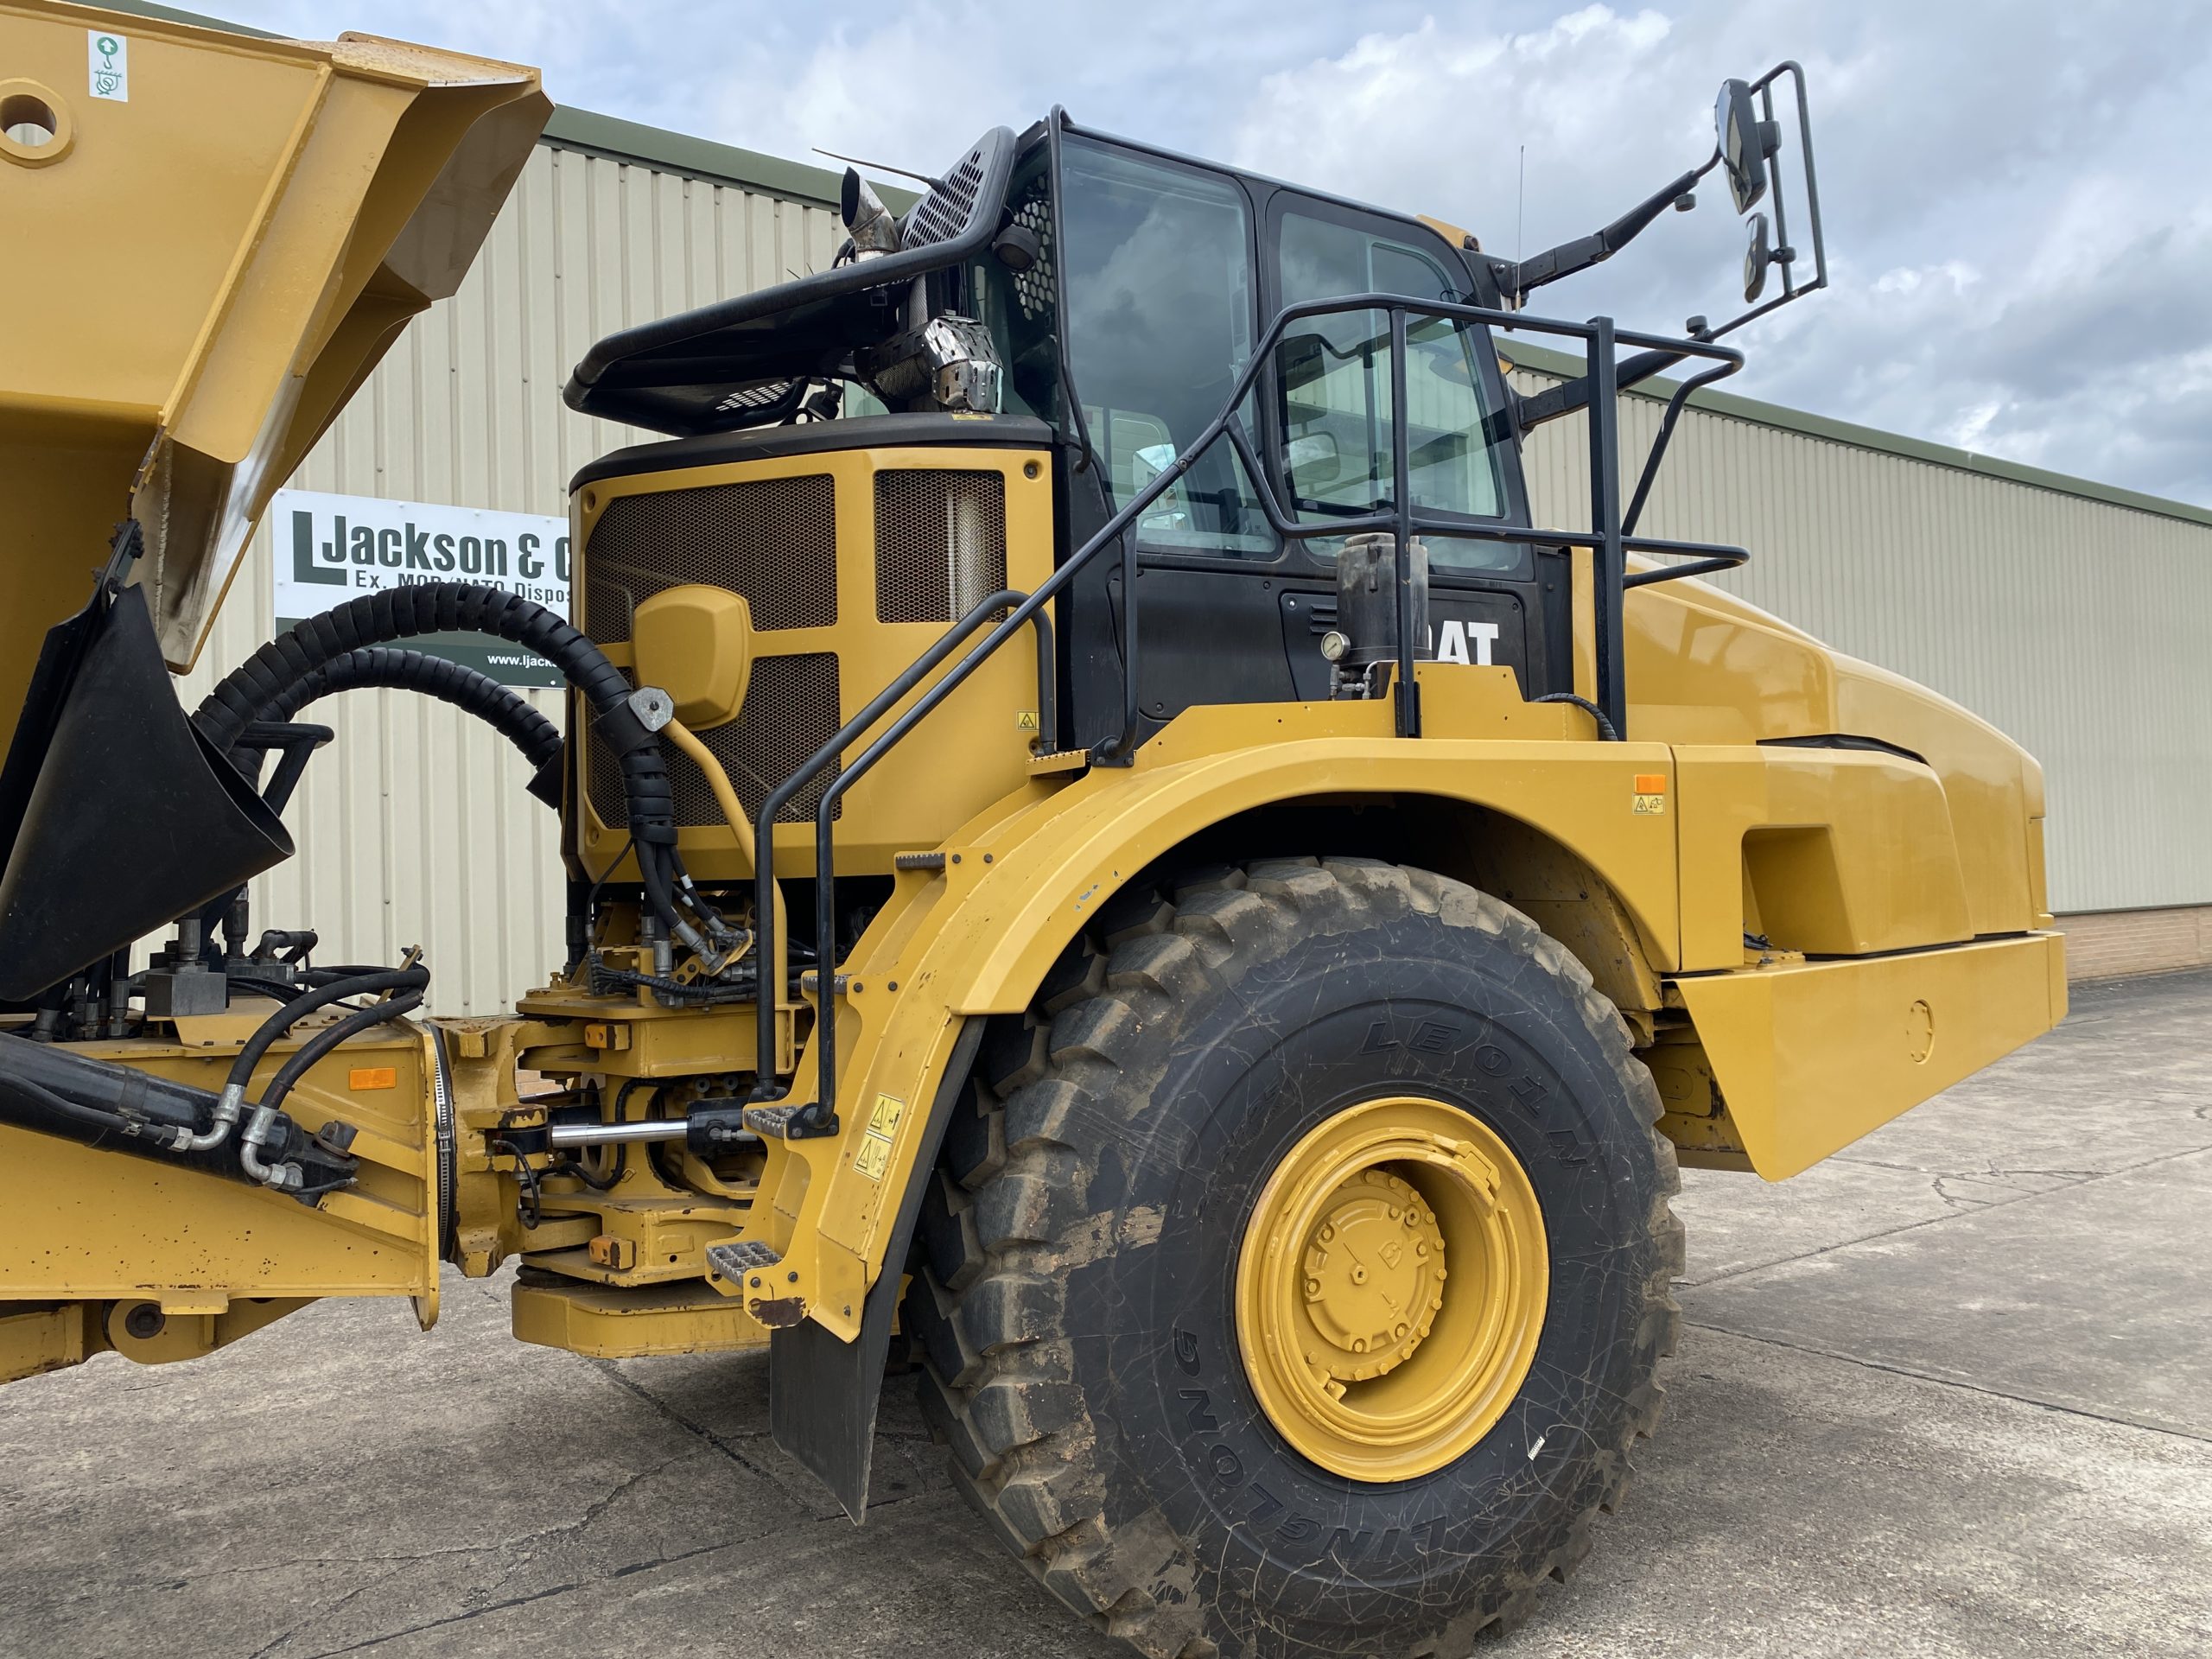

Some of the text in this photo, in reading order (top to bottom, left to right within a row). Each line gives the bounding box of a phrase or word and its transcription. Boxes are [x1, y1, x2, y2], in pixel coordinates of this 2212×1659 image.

[356, 570, 387, 589] Ex.
[518, 533, 545, 580] &
[1428, 620, 1499, 666] AT
[1173, 1327, 1447, 1564] LINGLONG
